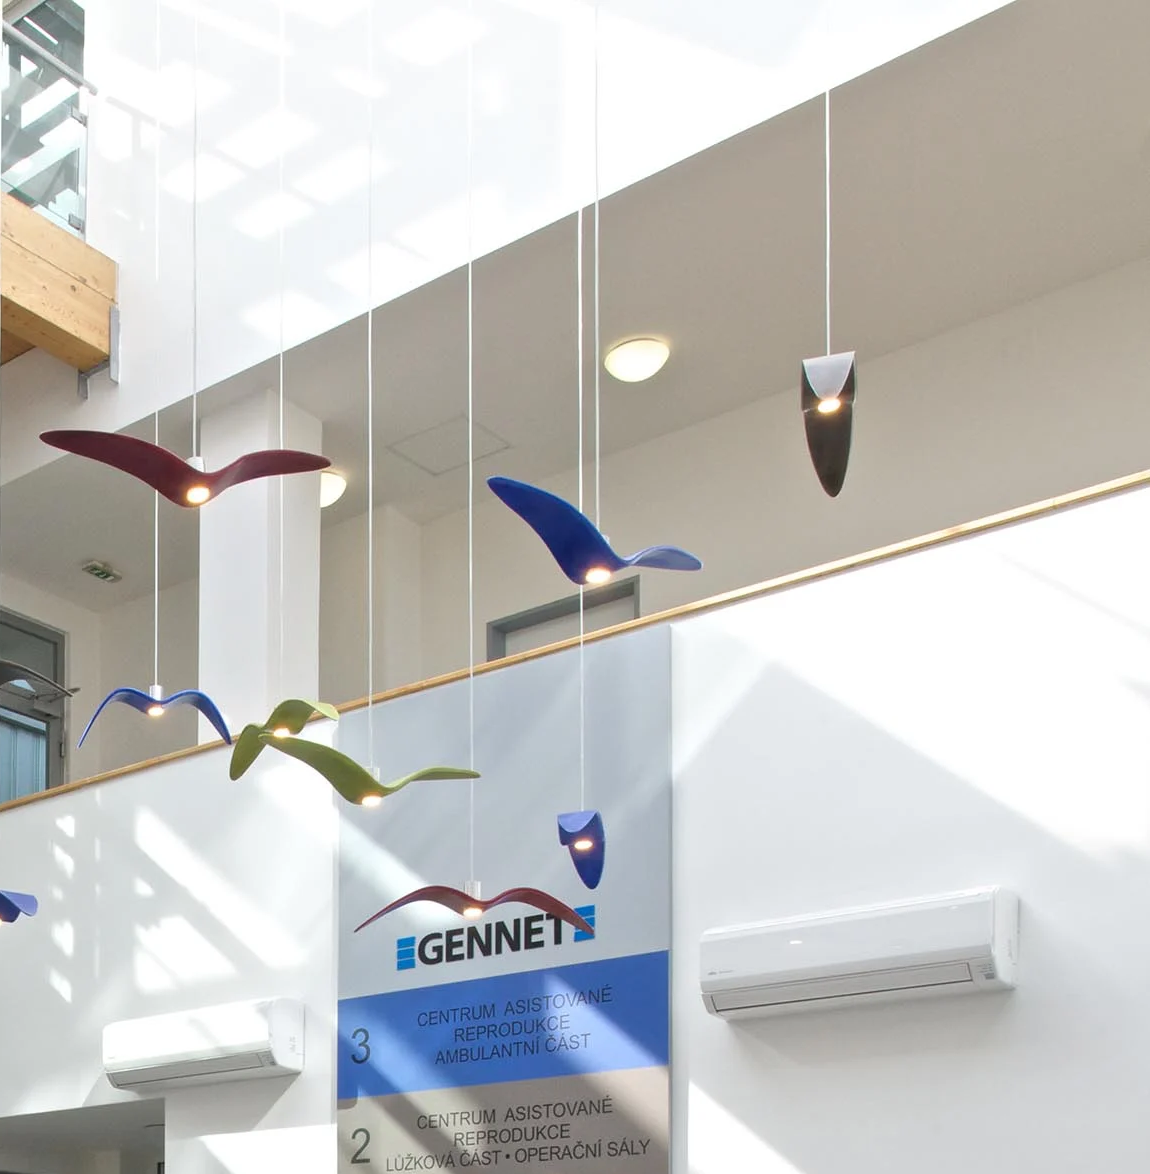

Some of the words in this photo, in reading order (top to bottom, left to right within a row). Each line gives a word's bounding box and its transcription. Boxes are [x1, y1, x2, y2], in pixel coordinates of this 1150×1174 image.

[418, 913, 563, 966] GENNET
[417, 1003, 496, 1028] CENTRUM
[504, 983, 614, 1017] ASISTOVANÉ
[351, 1027, 370, 1066] 3
[454, 1014, 570, 1043] REPRODUKCE
[435, 1036, 540, 1066] AMBULANTNÍ
[545, 1032, 592, 1052] ČÁST
[417, 1108, 496, 1130] CENTRUM
[504, 1095, 613, 1122] ASISTOVANÉ
[350, 1127, 371, 1165] 2
[453, 1123, 571, 1148] REPRODUKCE
[386, 1149, 455, 1173] LŮŽKOVÁ
[459, 1147, 501, 1168] ČÁST
[514, 1138, 602, 1164] OPERAČNÍ
[606, 1137, 651, 1158] SÁLY
